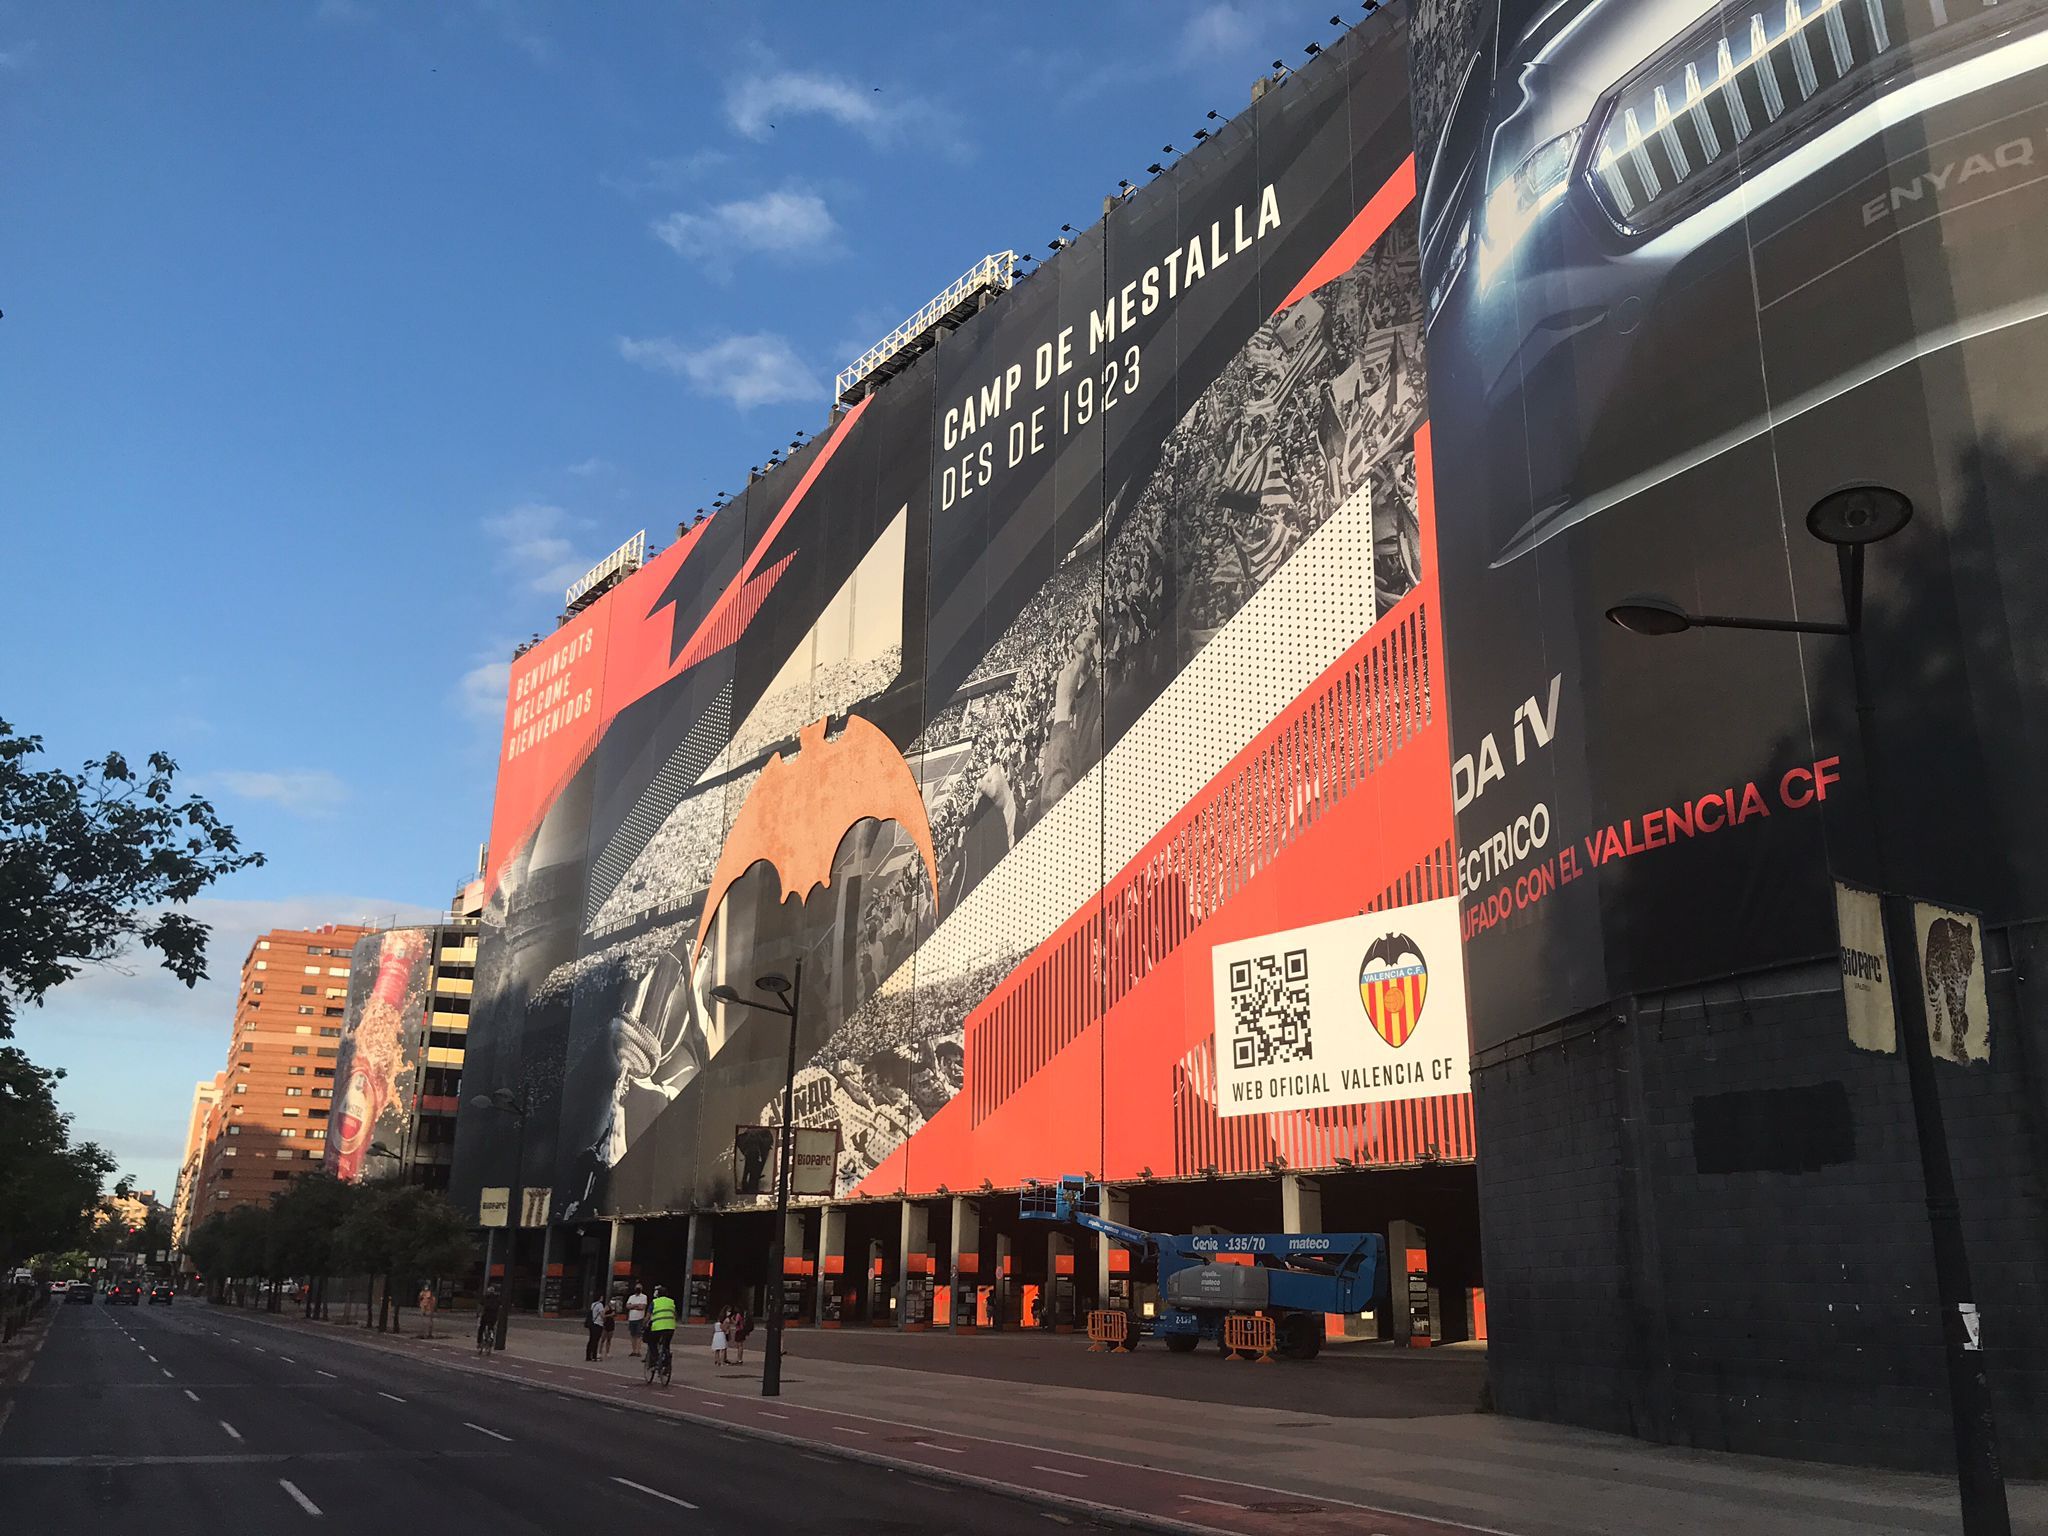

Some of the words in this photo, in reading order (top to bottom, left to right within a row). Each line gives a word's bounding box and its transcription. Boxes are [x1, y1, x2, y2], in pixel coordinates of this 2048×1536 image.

[1862, 137, 2034, 228] ENYAQ
[943, 363, 1022, 451] CAMP
[1035, 325, 1073, 391] DE
[1089, 183, 1281, 354] MESTALLA
[942, 442, 993, 511] DES
[1009, 406, 1045, 469] DE
[1063, 345, 1141, 435] 1923
[513, 672, 571, 731] WELCOME
[516, 628, 593, 702] BENVINGUTS
[508, 687, 592, 761] BIENVENIDOS
[1451, 733, 1506, 816] DA
[1515, 857, 1556, 910] CON
[1559, 845, 1583, 886] EL
[1584, 782, 1770, 868] VALENCIA
[1779, 756, 1840, 809] CF
[1364, 970, 1405, 982] VALENCIA
[1232, 1080, 1263, 1102] WEB
[1269, 1072, 1330, 1098] OFICIAL
[1341, 1061, 1424, 1090] VALENCIA
[1432, 1057, 1453, 1081] CF
[1192, 1236, 1218, 1250] Genie
[1289, 1238, 1330, 1249] mateco
